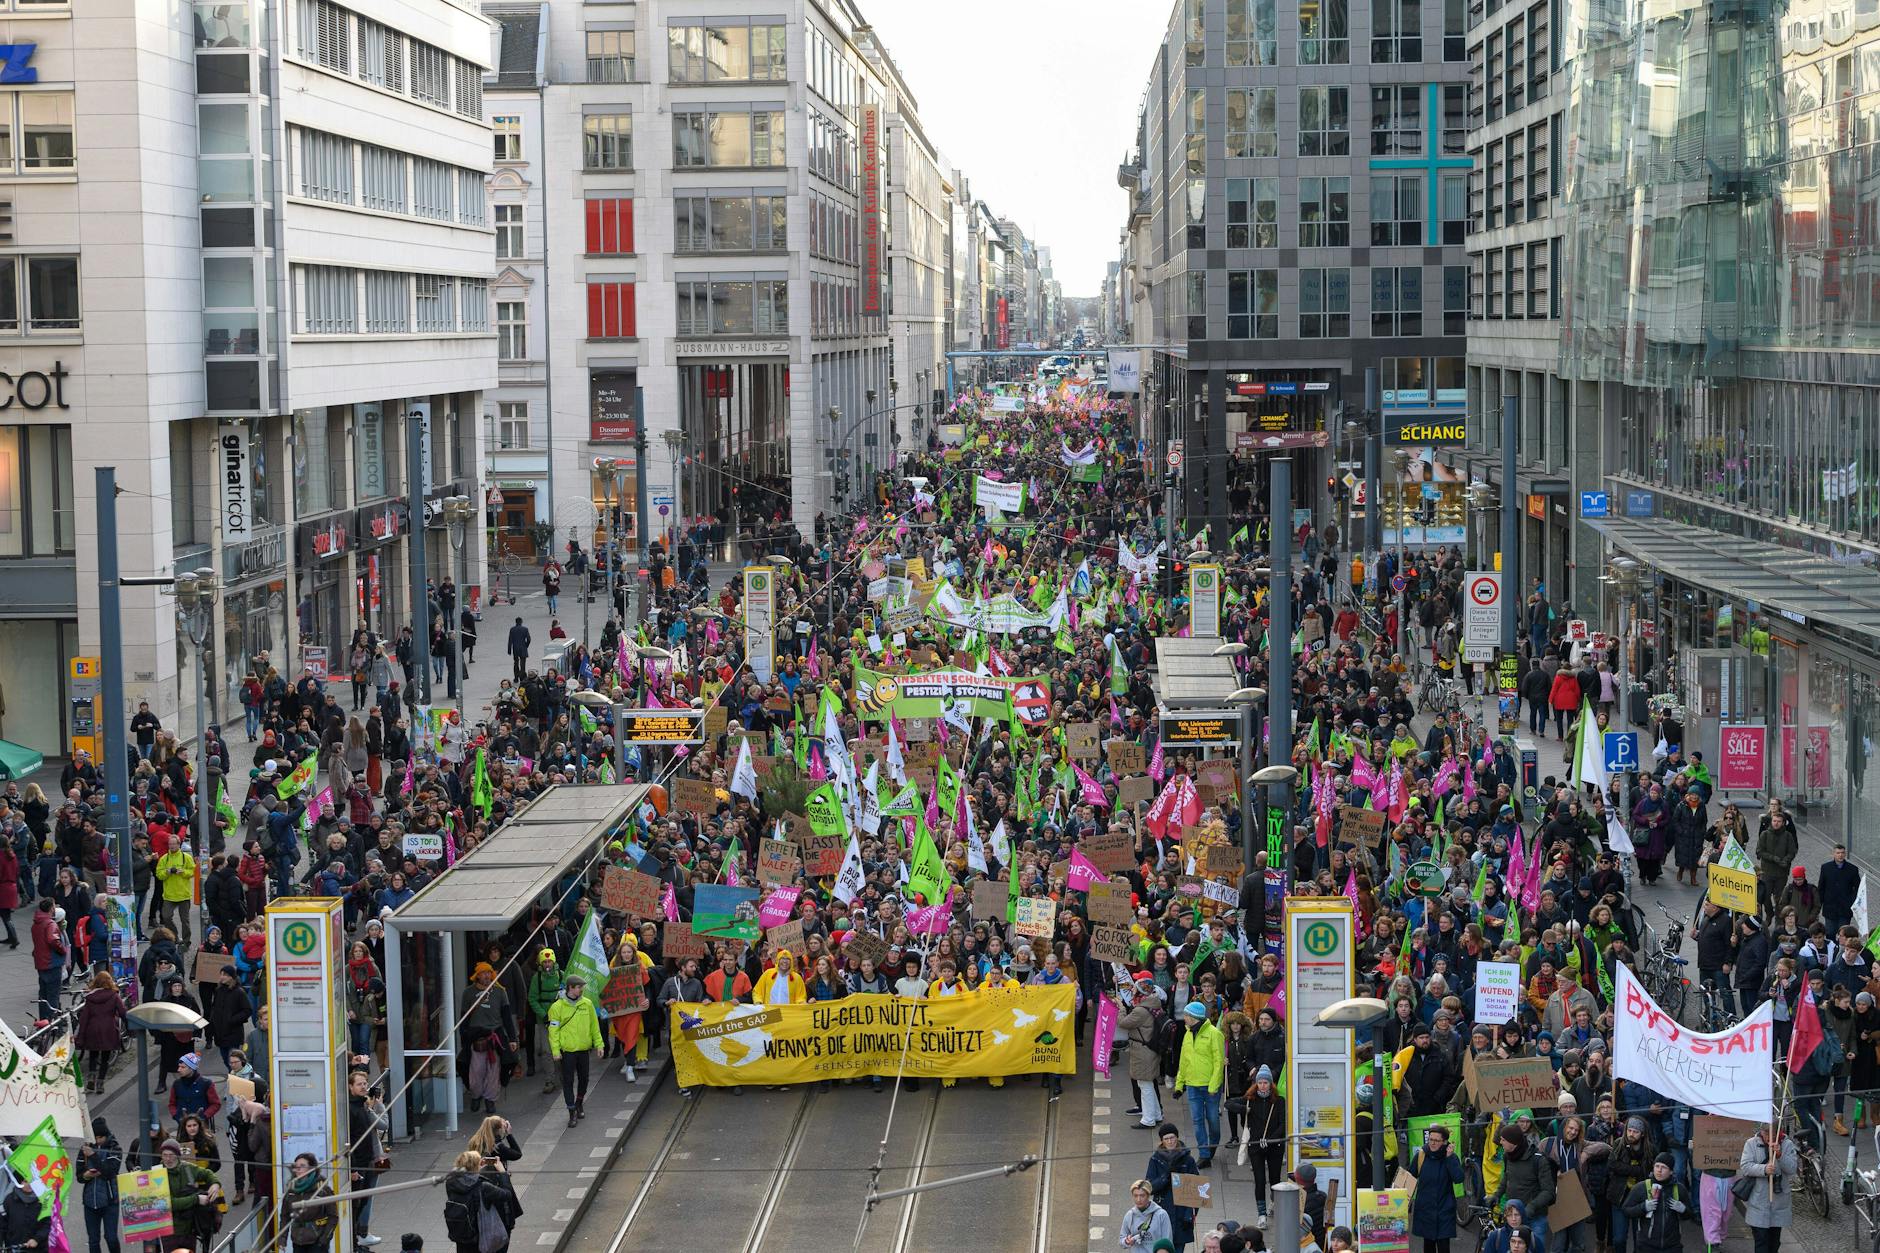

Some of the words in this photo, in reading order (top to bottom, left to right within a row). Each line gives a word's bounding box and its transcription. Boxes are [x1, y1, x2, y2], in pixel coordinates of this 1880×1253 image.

[676, 343, 768, 354] DUSSMANN-HAUS
[222, 434, 246, 535] ginatricot
[1472, 627, 1496, 635] Anlieger
[1467, 649, 1482, 658] 100
[895, 674, 949, 685] INSEKTEN
[1500, 677, 1518, 689] 365
[956, 687, 1003, 700] STOPPEN!
[1117, 748, 1139, 758] VIEL
[1728, 740, 1758, 755] SALE
[1115, 758, 1141, 771] FALT
[407, 837, 419, 846] ISS
[420, 838, 439, 846] TOFU
[803, 834, 843, 851] LASST
[764, 840, 797, 857] RETTET
[770, 853, 782, 861] DIE
[804, 851, 819, 861] DIE
[1711, 872, 1754, 895] Kelheim
[667, 925, 693, 936] ESSE
[1095, 928, 1111, 942] GO
[1111, 930, 1134, 946] FORK
[675, 935, 688, 945] IST
[1094, 941, 1130, 959] YOURSELF
[1499, 969, 1512, 977] BIN
[1488, 977, 1509, 985] SOOO
[813, 1005, 874, 1030] EU-GELD
[879, 999, 934, 1027] NÜTZT,
[697, 1025, 724, 1038] Mind
[725, 1019, 744, 1032] the
[746, 1014, 768, 1027] GAP
[763, 1036, 821, 1060] WENN'S
[828, 1034, 848, 1055] DIE
[853, 1030, 914, 1054] UMWELT
[920, 1027, 985, 1053] SCHÜTZT
[1690, 1021, 1772, 1055] STATT
[1034, 1047, 1059, 1055] BUND
[814, 1058, 935, 1071] #BINSENWEISHEIT
[1031, 1053, 1061, 1064] jugend
[1636, 1033, 1742, 1092] ACKERGIFT
[1503, 1073, 1529, 1088] statt
[1484, 1085, 1556, 1105] WELTMARKT
[1704, 1154, 1732, 1166] Bienen!
